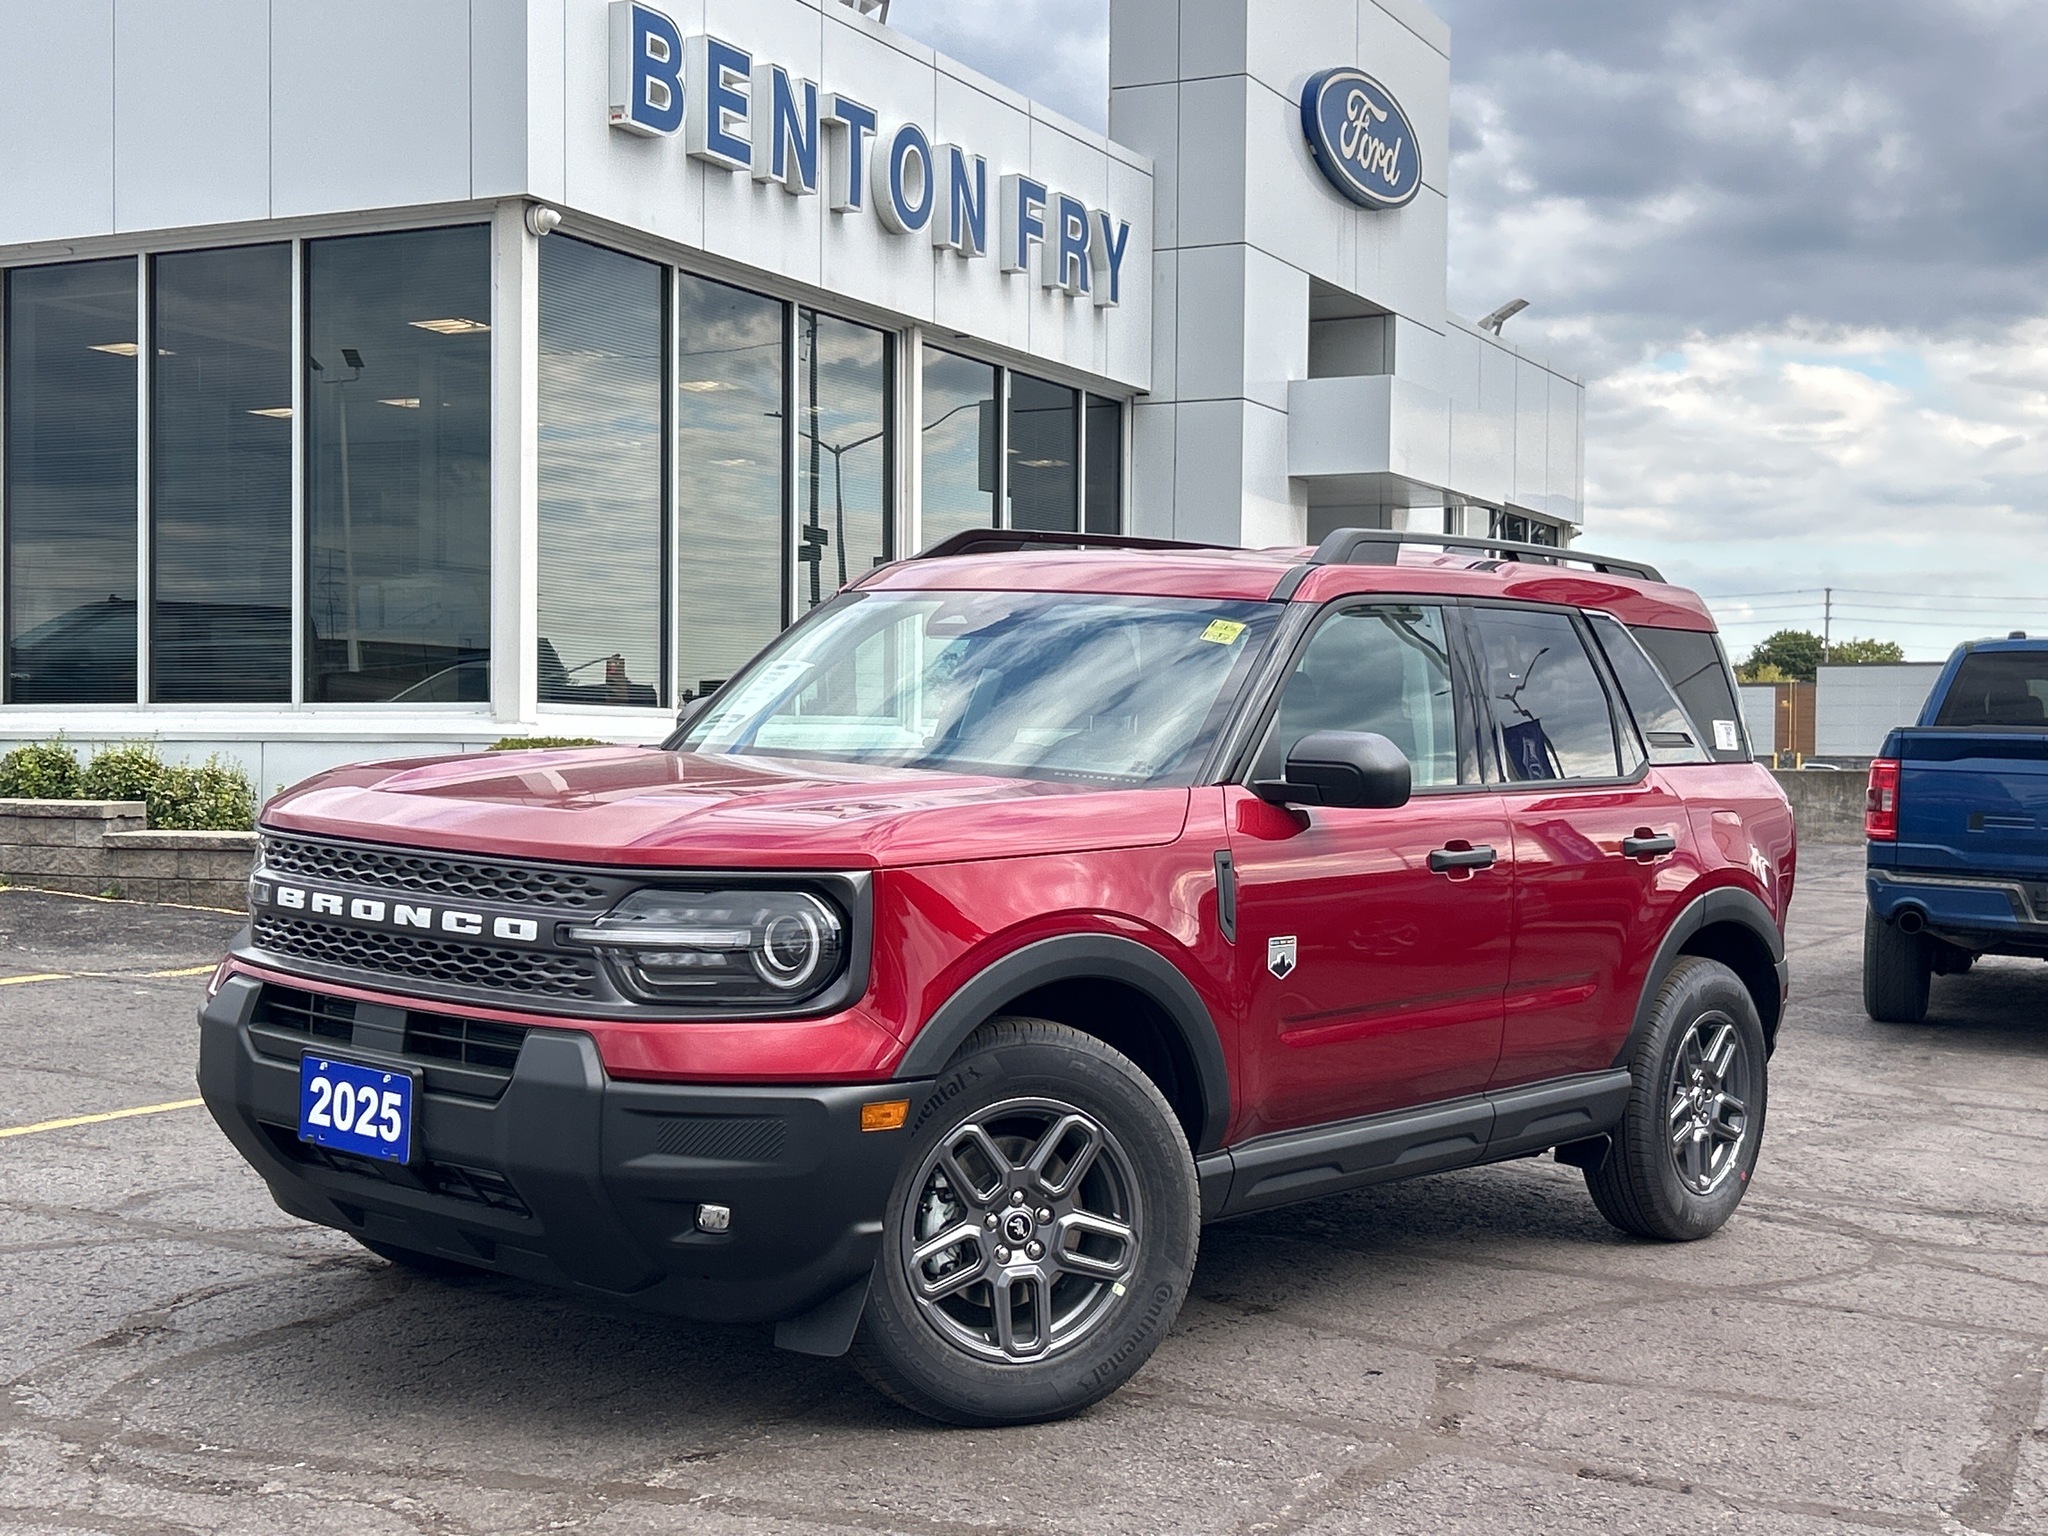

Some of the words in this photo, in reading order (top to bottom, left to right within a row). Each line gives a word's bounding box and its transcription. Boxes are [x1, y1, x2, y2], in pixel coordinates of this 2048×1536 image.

[630, 1, 988, 259] BENTON
[1015, 176, 1132, 306] FRY
[1340, 88, 1402, 187] Ford
[277, 886, 539, 942] BRONCO
[307, 1076, 402, 1143] 2025
[1091, 1281, 1173, 1385] Continental
